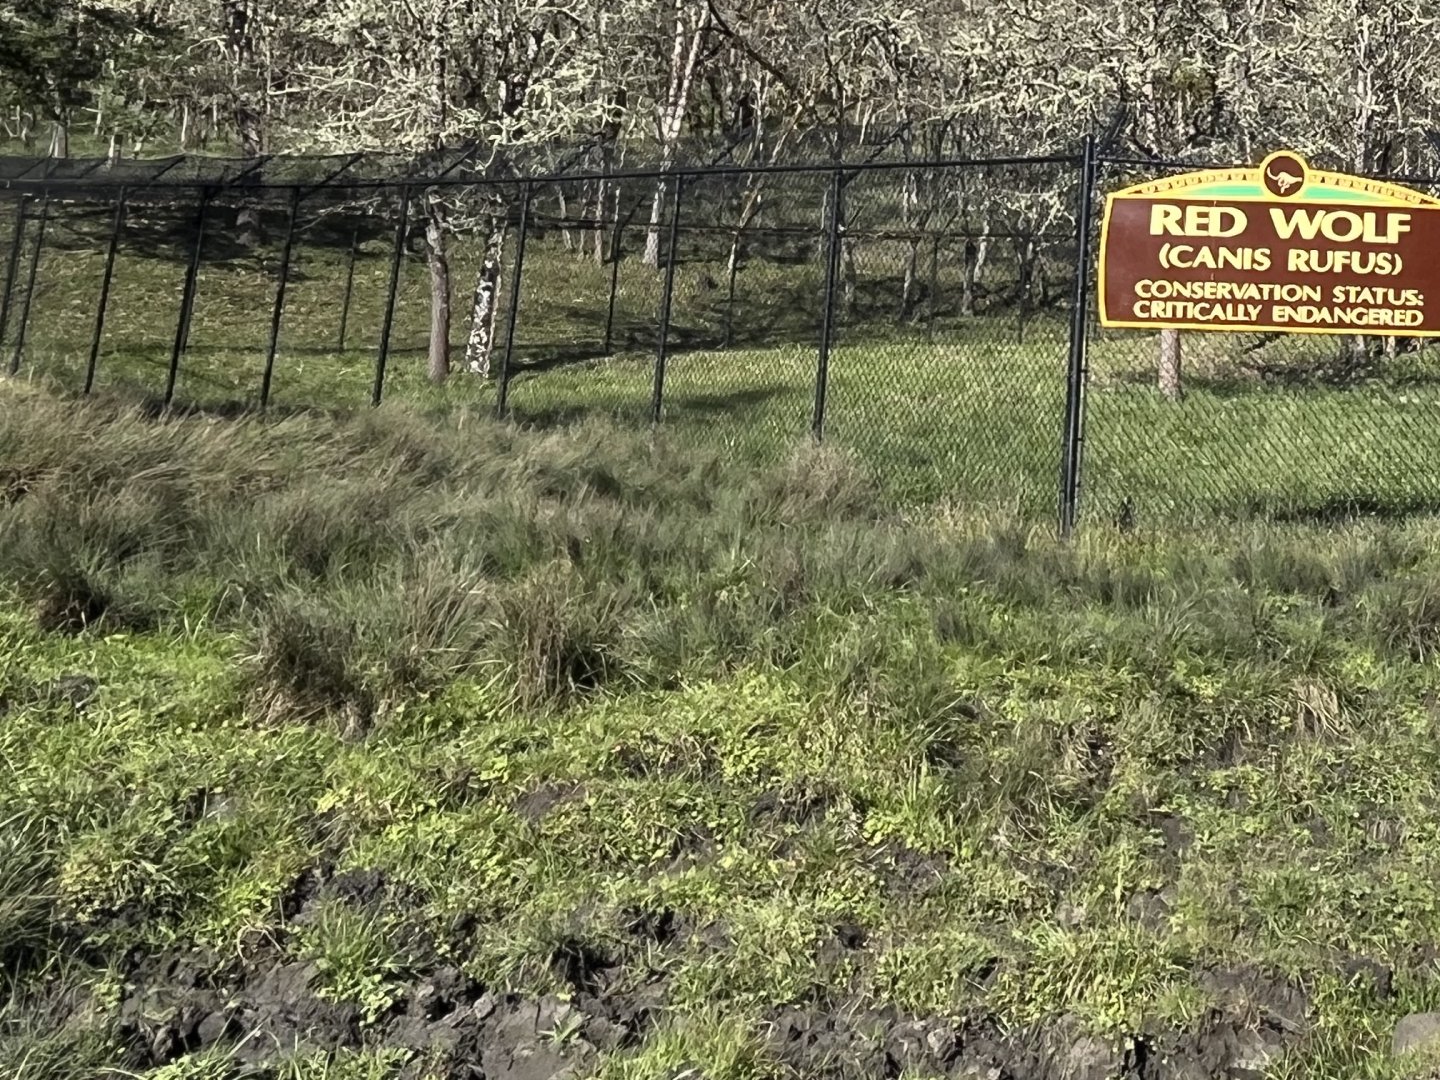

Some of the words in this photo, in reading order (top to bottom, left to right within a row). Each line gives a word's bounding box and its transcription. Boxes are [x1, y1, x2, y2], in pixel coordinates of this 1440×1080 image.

[1150, 204, 1248, 238] RED
[1269, 208, 1411, 244] WOLF
[1158, 243, 1270, 272] (CANIS
[1288, 249, 1402, 276] RUFUS)
[1134, 279, 1322, 303] CONSERVATION
[1332, 286, 1424, 307] STATUS:
[1133, 300, 1262, 322] CRITICALLY
[1272, 305, 1424, 327] ENDANGERED
